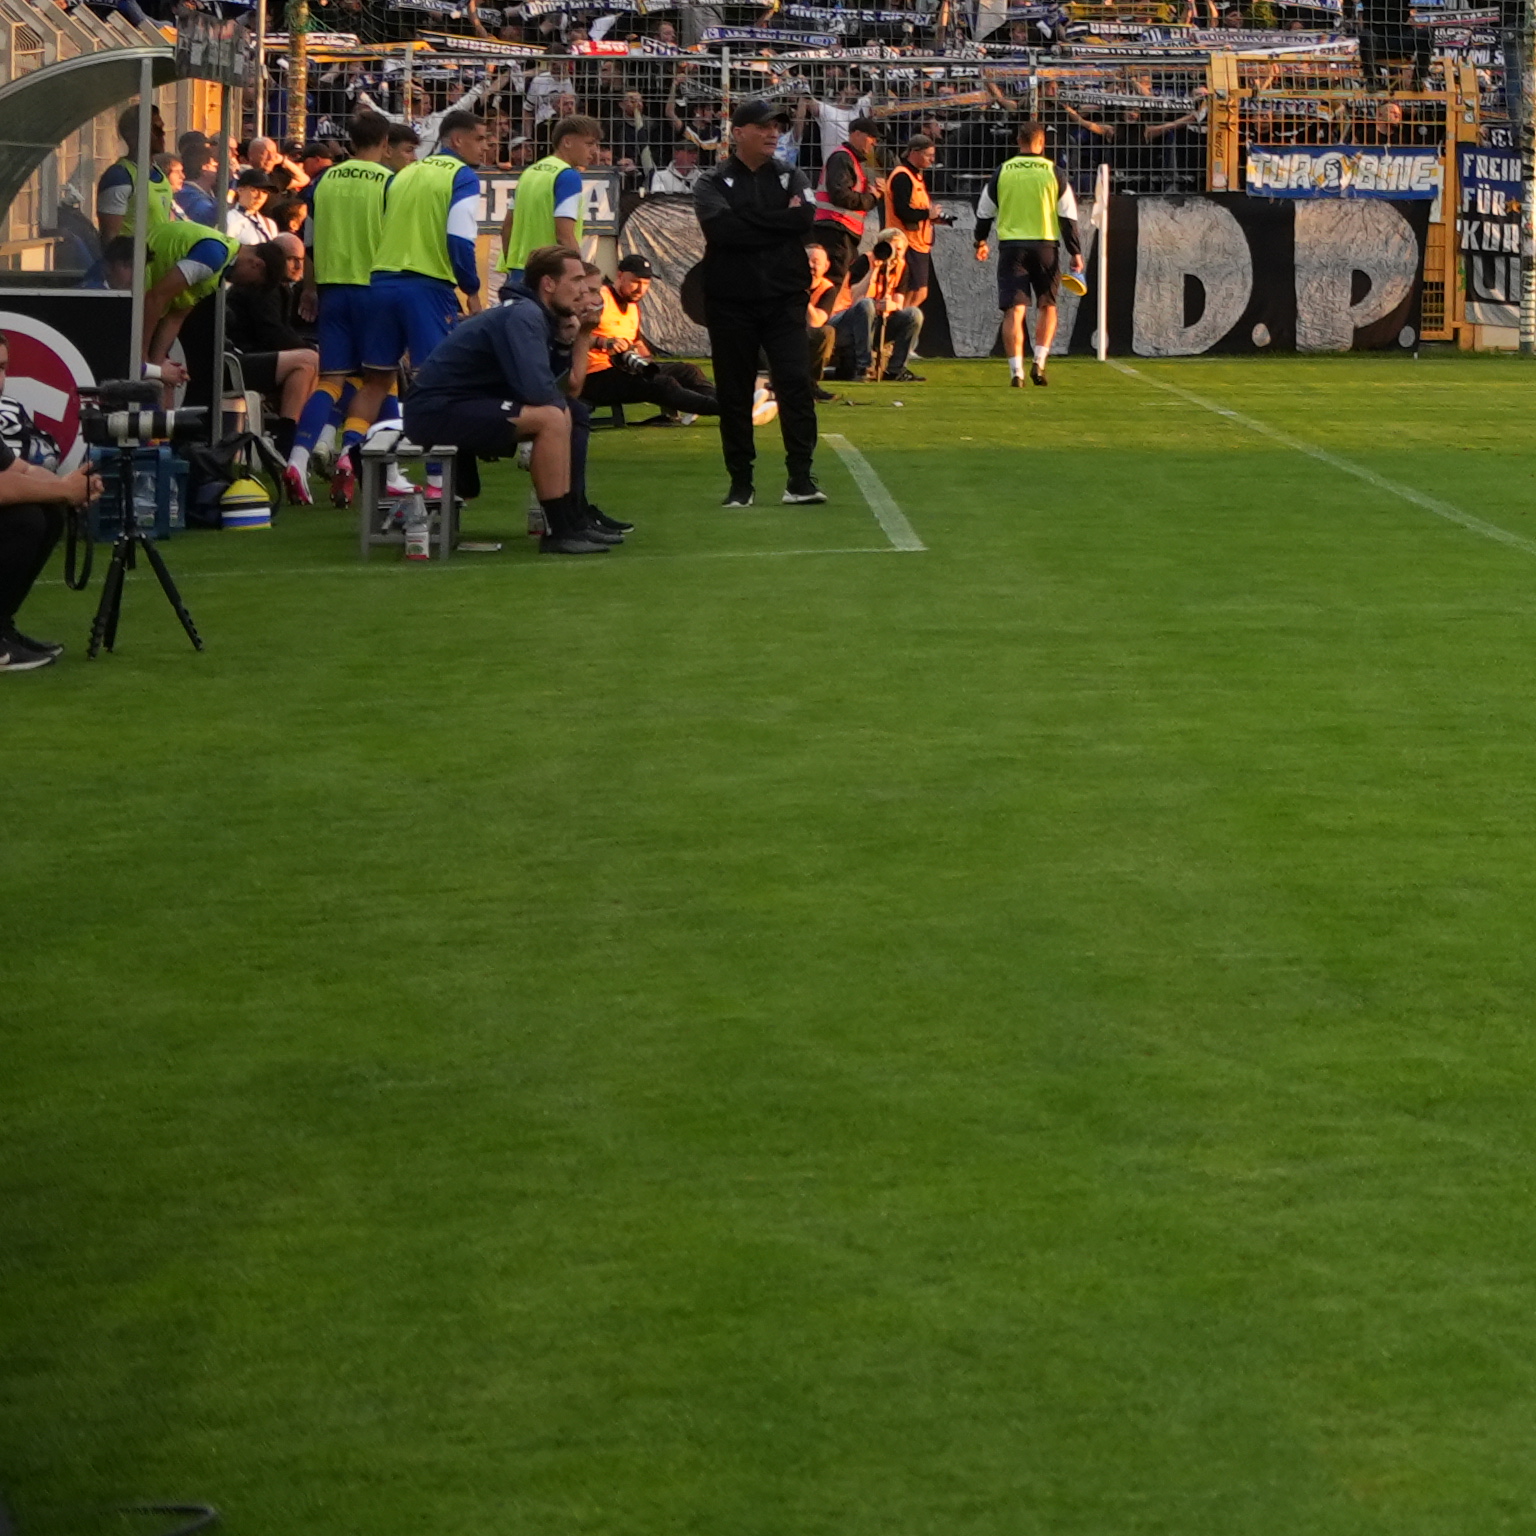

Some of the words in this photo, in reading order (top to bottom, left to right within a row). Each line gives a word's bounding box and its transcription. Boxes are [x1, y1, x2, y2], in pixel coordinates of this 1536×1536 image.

[327, 166, 386, 184] macron
[1004, 161, 1051, 172] macron
[1462, 183, 1508, 217] FÜR
